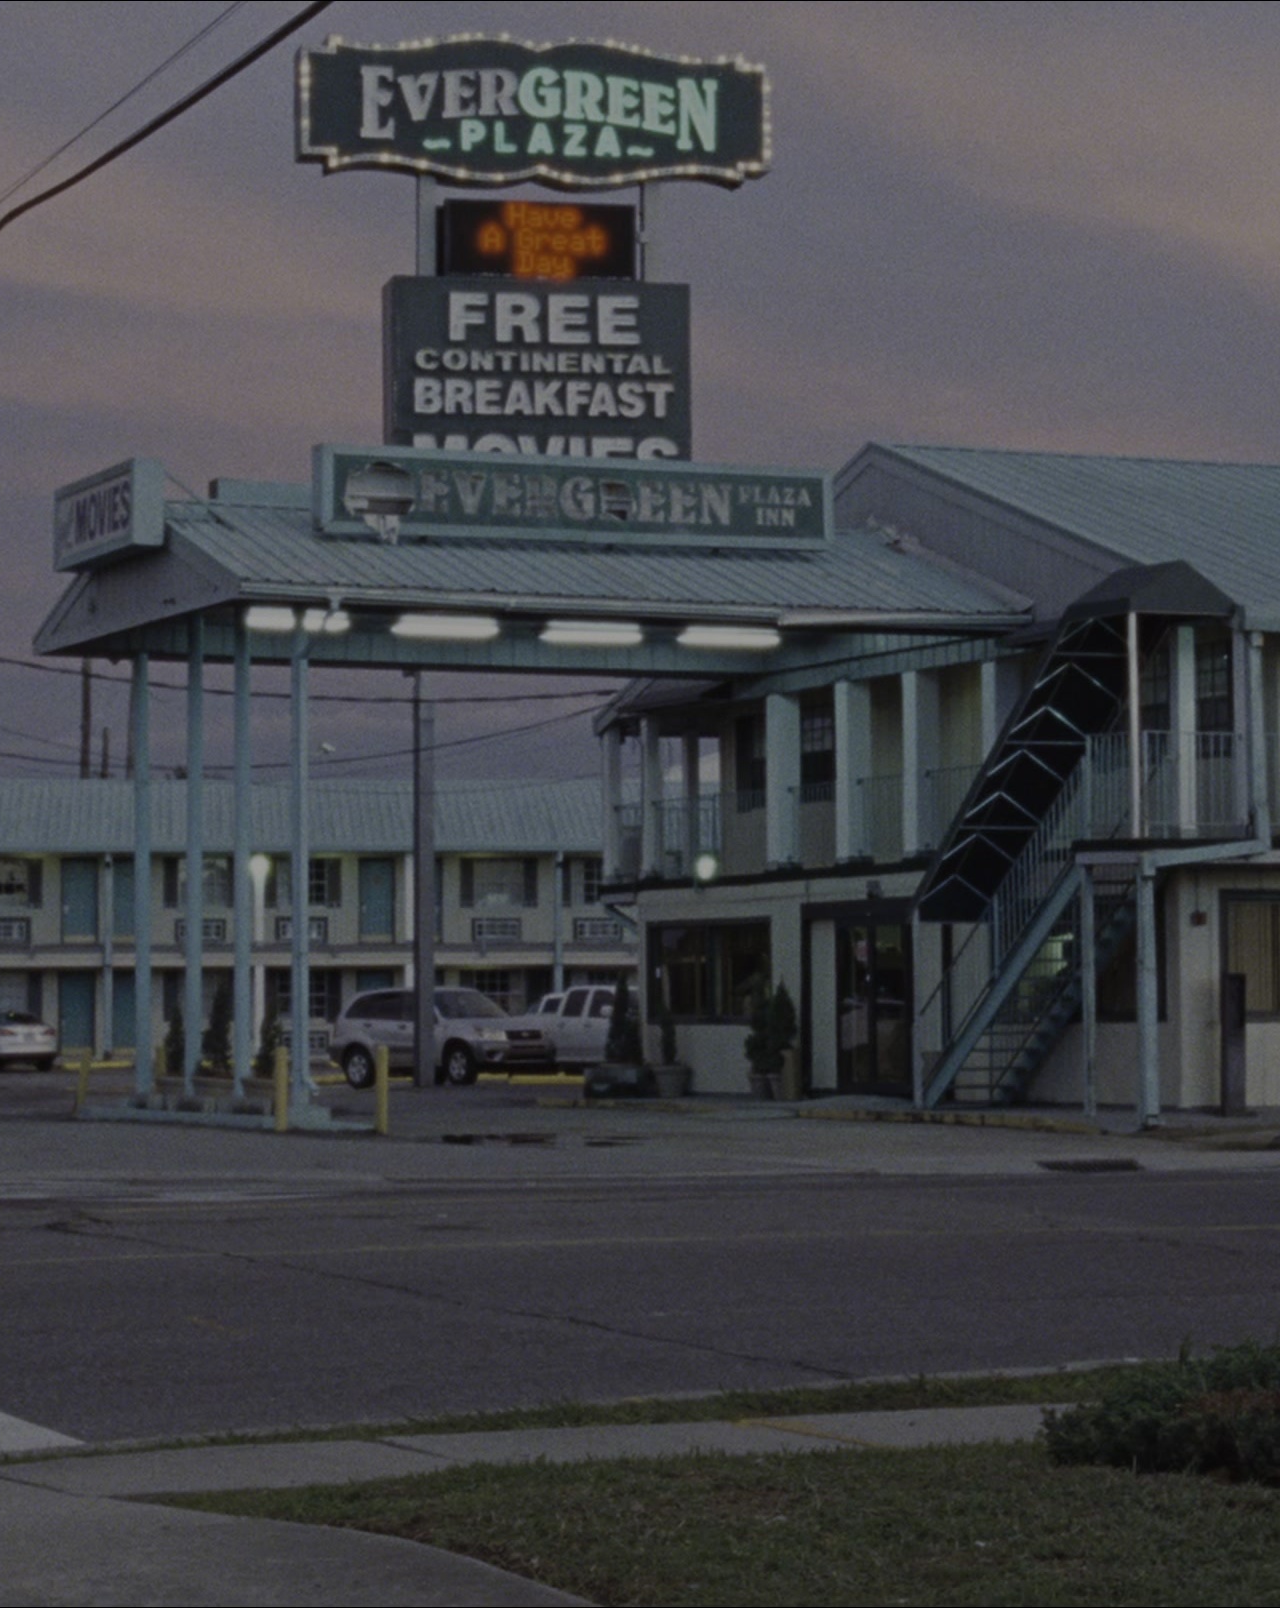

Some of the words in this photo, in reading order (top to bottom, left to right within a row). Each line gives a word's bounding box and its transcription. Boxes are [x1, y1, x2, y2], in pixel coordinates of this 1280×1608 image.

[359, 65, 718, 153] EVERGREEN
[460, 119, 623, 157] PLAZA
[506, 203, 577, 228] Have
[519, 228, 604, 252] Great
[519, 252, 570, 277] Day
[447, 291, 641, 346] FREE
[414, 347, 673, 376] CONTINENTAL
[412, 376, 675, 419] BREAKFAST
[738, 484, 813, 507] PLAZA
[755, 506, 796, 528] INN
